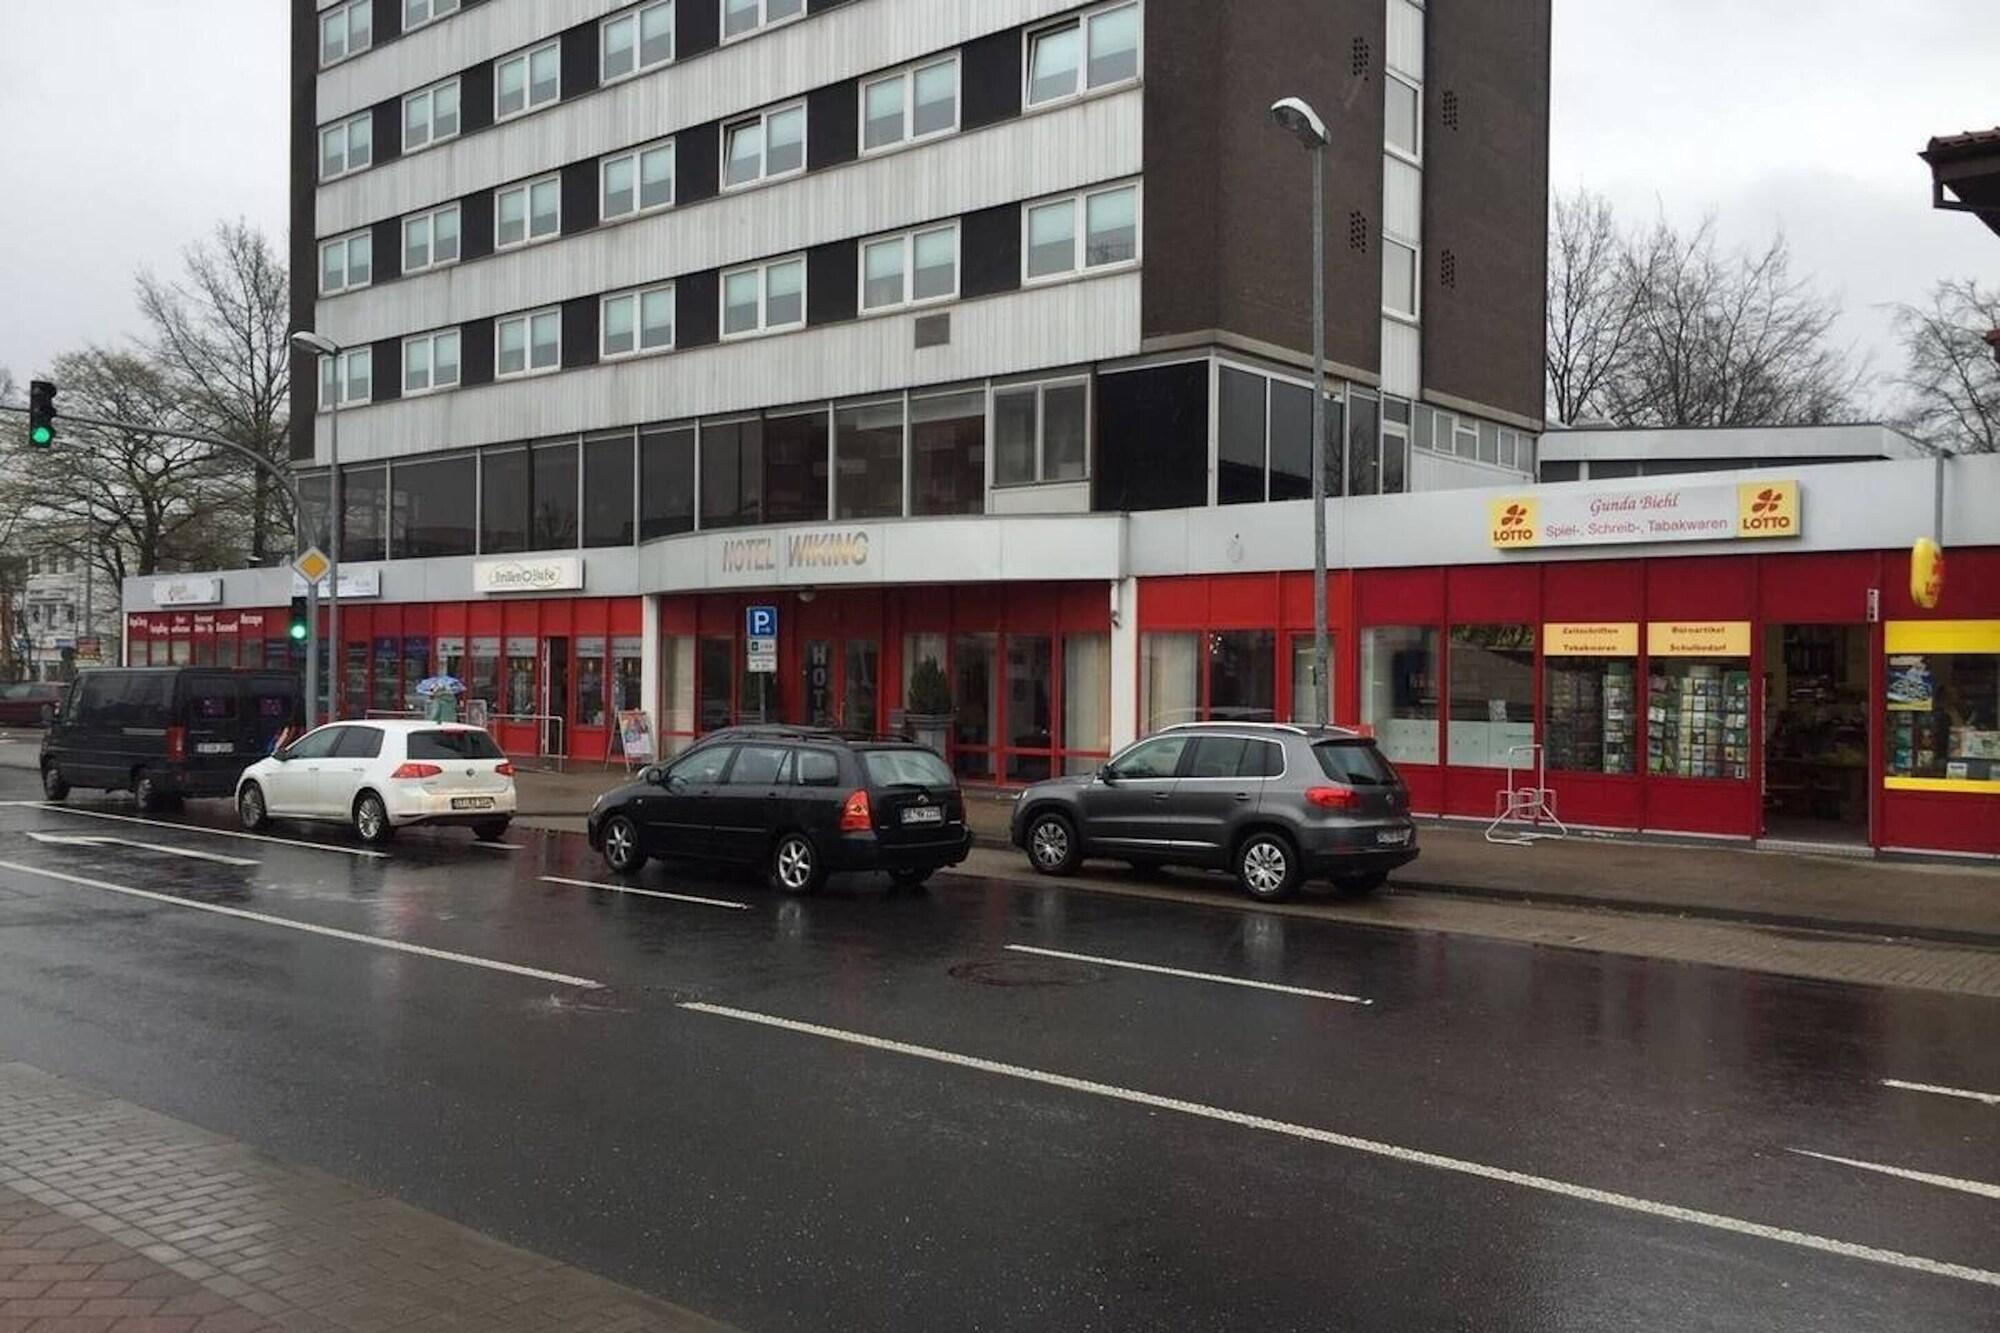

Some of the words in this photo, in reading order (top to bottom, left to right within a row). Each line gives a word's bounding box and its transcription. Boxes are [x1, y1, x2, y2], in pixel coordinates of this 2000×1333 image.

[1590, 497, 1637, 517] Gunda
[1640, 491, 1680, 510] Biehl
[1648, 518, 1728, 533] Tabakwaren
[1741, 516, 1790, 530] LOTTO
[1493, 529, 1533, 542] LOTTO
[722, 537, 775, 573] HOTEL
[788, 531, 869, 568] WIKING
[754, 610, 770, 634] P
[1563, 644, 1617, 652] Tabakwaren
[1670, 643, 1727, 652] Schulbedarf
